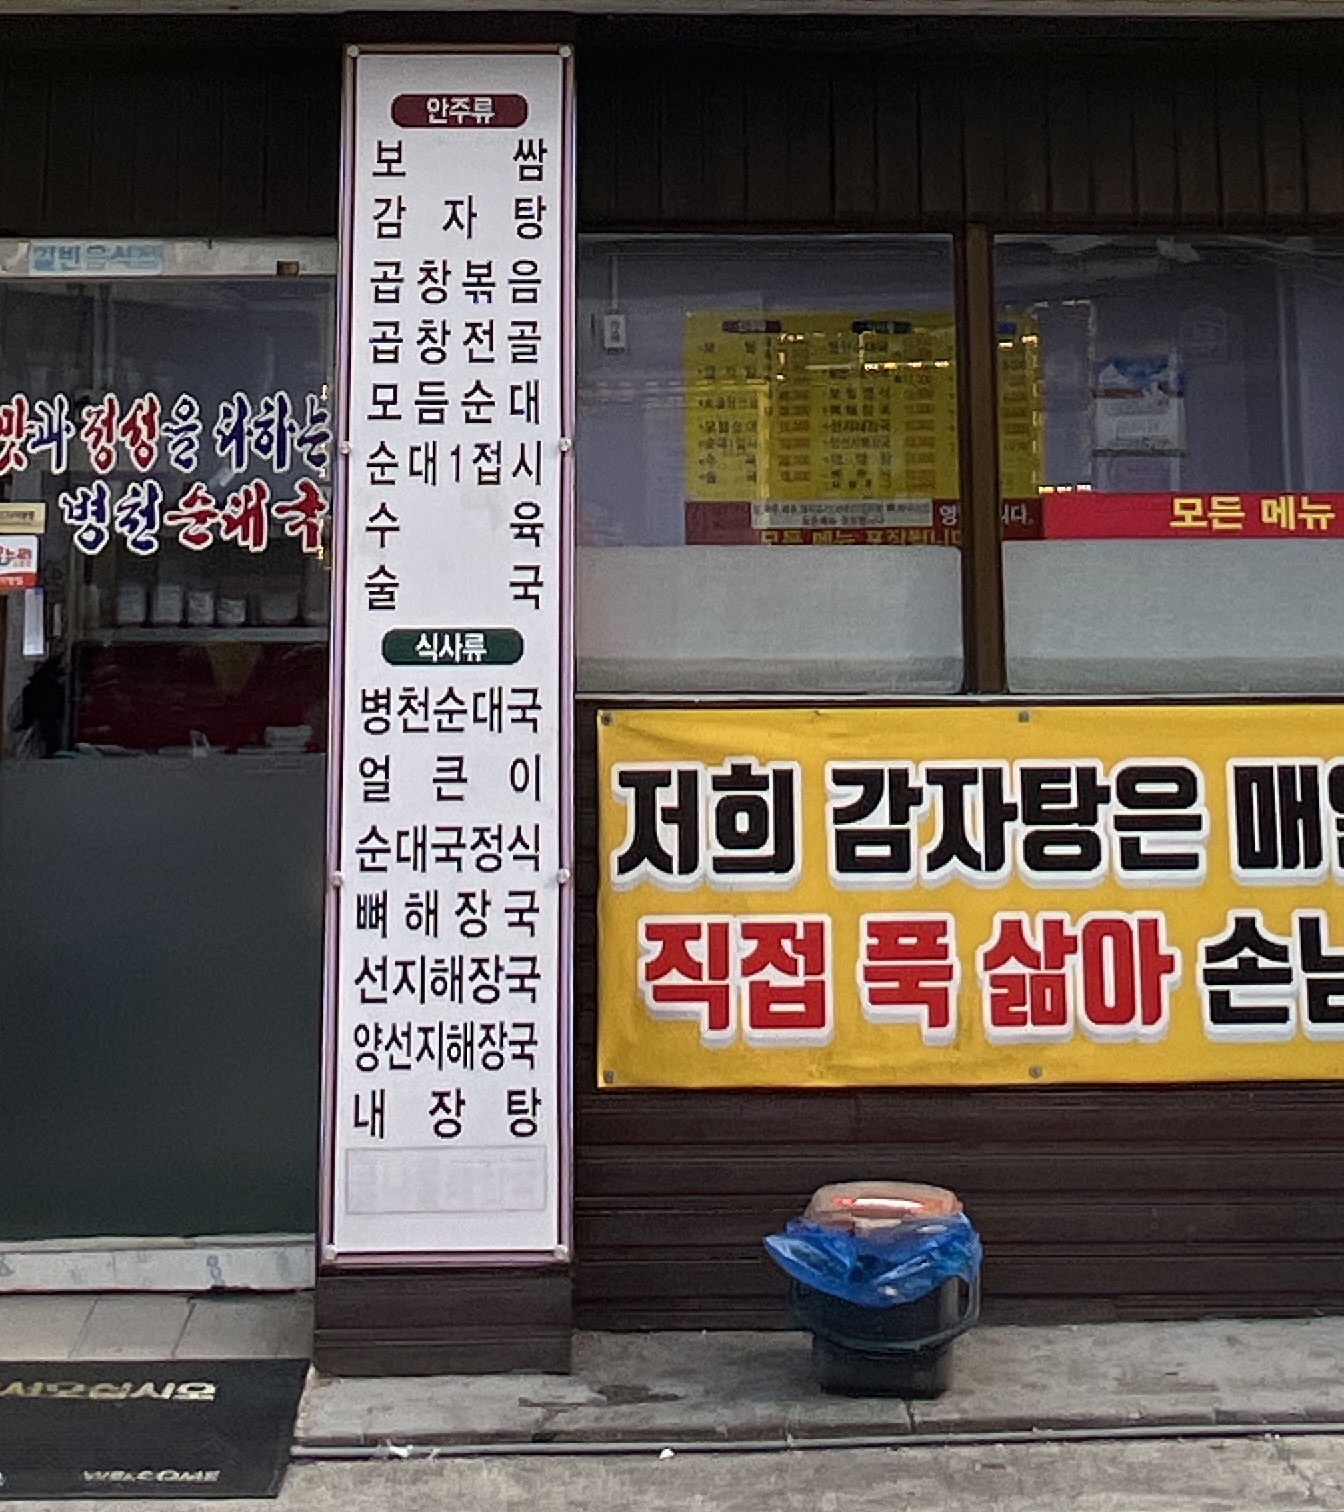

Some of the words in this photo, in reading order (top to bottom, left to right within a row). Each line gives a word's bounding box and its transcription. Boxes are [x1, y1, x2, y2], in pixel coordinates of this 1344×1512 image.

[426, 96, 496, 124] 안주류
[369, 259, 543, 305] 곱창볶음
[368, 319, 542, 365] 곱창전골
[366, 380, 542, 426] 모듬순대
[81, 391, 203, 475] 정성을
[1168, 496, 1245, 531] 모든
[1260, 496, 1336, 531] 메뉴
[415, 632, 488, 663] 식사류
[360, 684, 543, 736] 병천순대국
[613, 760, 799, 879] 저희
[829, 760, 1206, 877] 감자탕은
[355, 823, 542, 873] 순대국정식
[354, 954, 543, 1005] 선지해장국
[642, 917, 829, 1034] 직접
[860, 918, 956, 1031] 푹
[982, 915, 1178, 1029] 삶아
[353, 1020, 540, 1072] 양선지해장국
